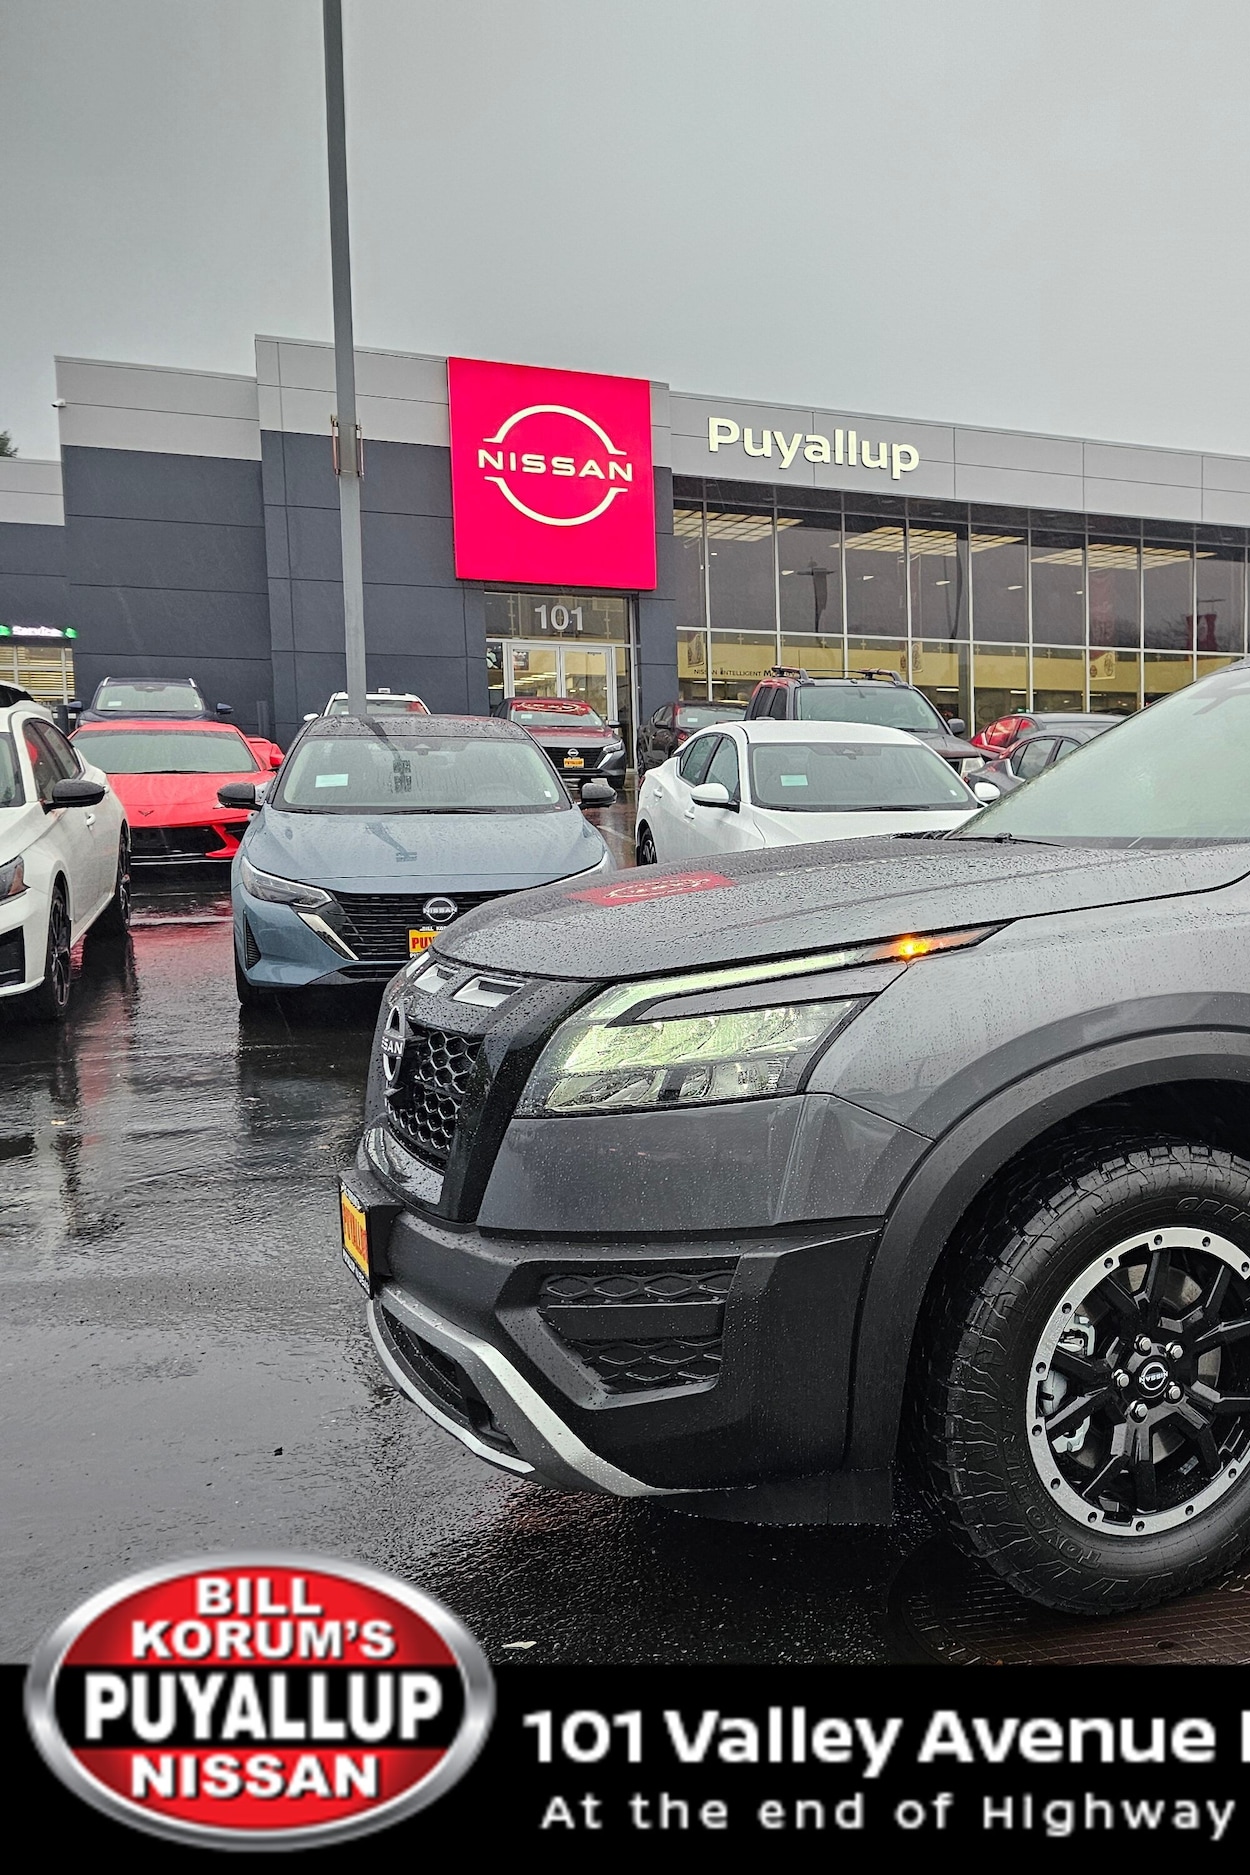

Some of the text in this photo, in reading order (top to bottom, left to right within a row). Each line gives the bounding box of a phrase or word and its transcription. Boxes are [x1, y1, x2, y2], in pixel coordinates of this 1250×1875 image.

[708, 416, 920, 480] Puyallup
[477, 448, 633, 482] NISSAN
[534, 604, 584, 631] 101
[423, 906, 457, 914] NISSAN
